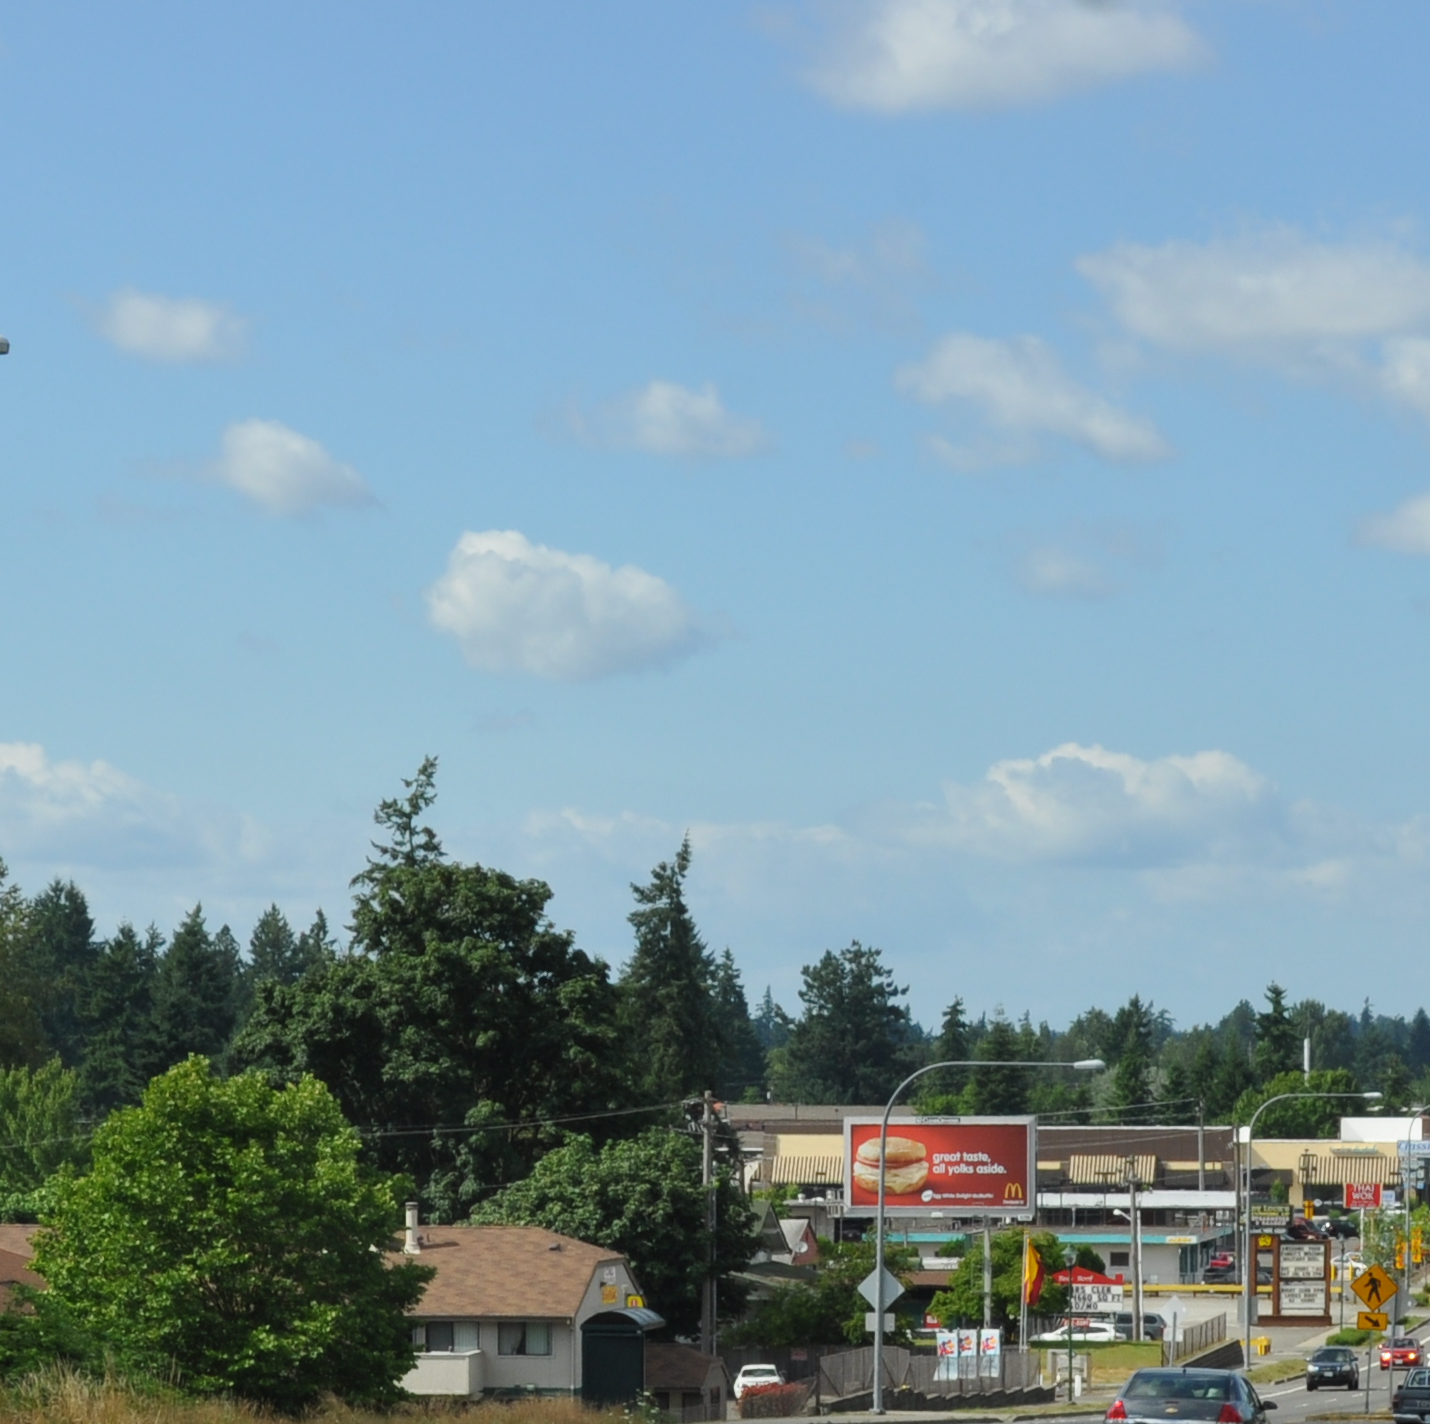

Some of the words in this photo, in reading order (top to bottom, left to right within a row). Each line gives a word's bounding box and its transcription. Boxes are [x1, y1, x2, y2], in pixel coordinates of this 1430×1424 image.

[932, 1151, 961, 1164] great
[962, 1152, 991, 1163] taste,
[932, 1163, 946, 1174] all
[947, 1163, 974, 1176] yolks
[976, 1163, 1007, 1174] aside.
[1353, 1183, 1375, 1192] THAI
[1352, 1192, 1374, 1200] WOK
